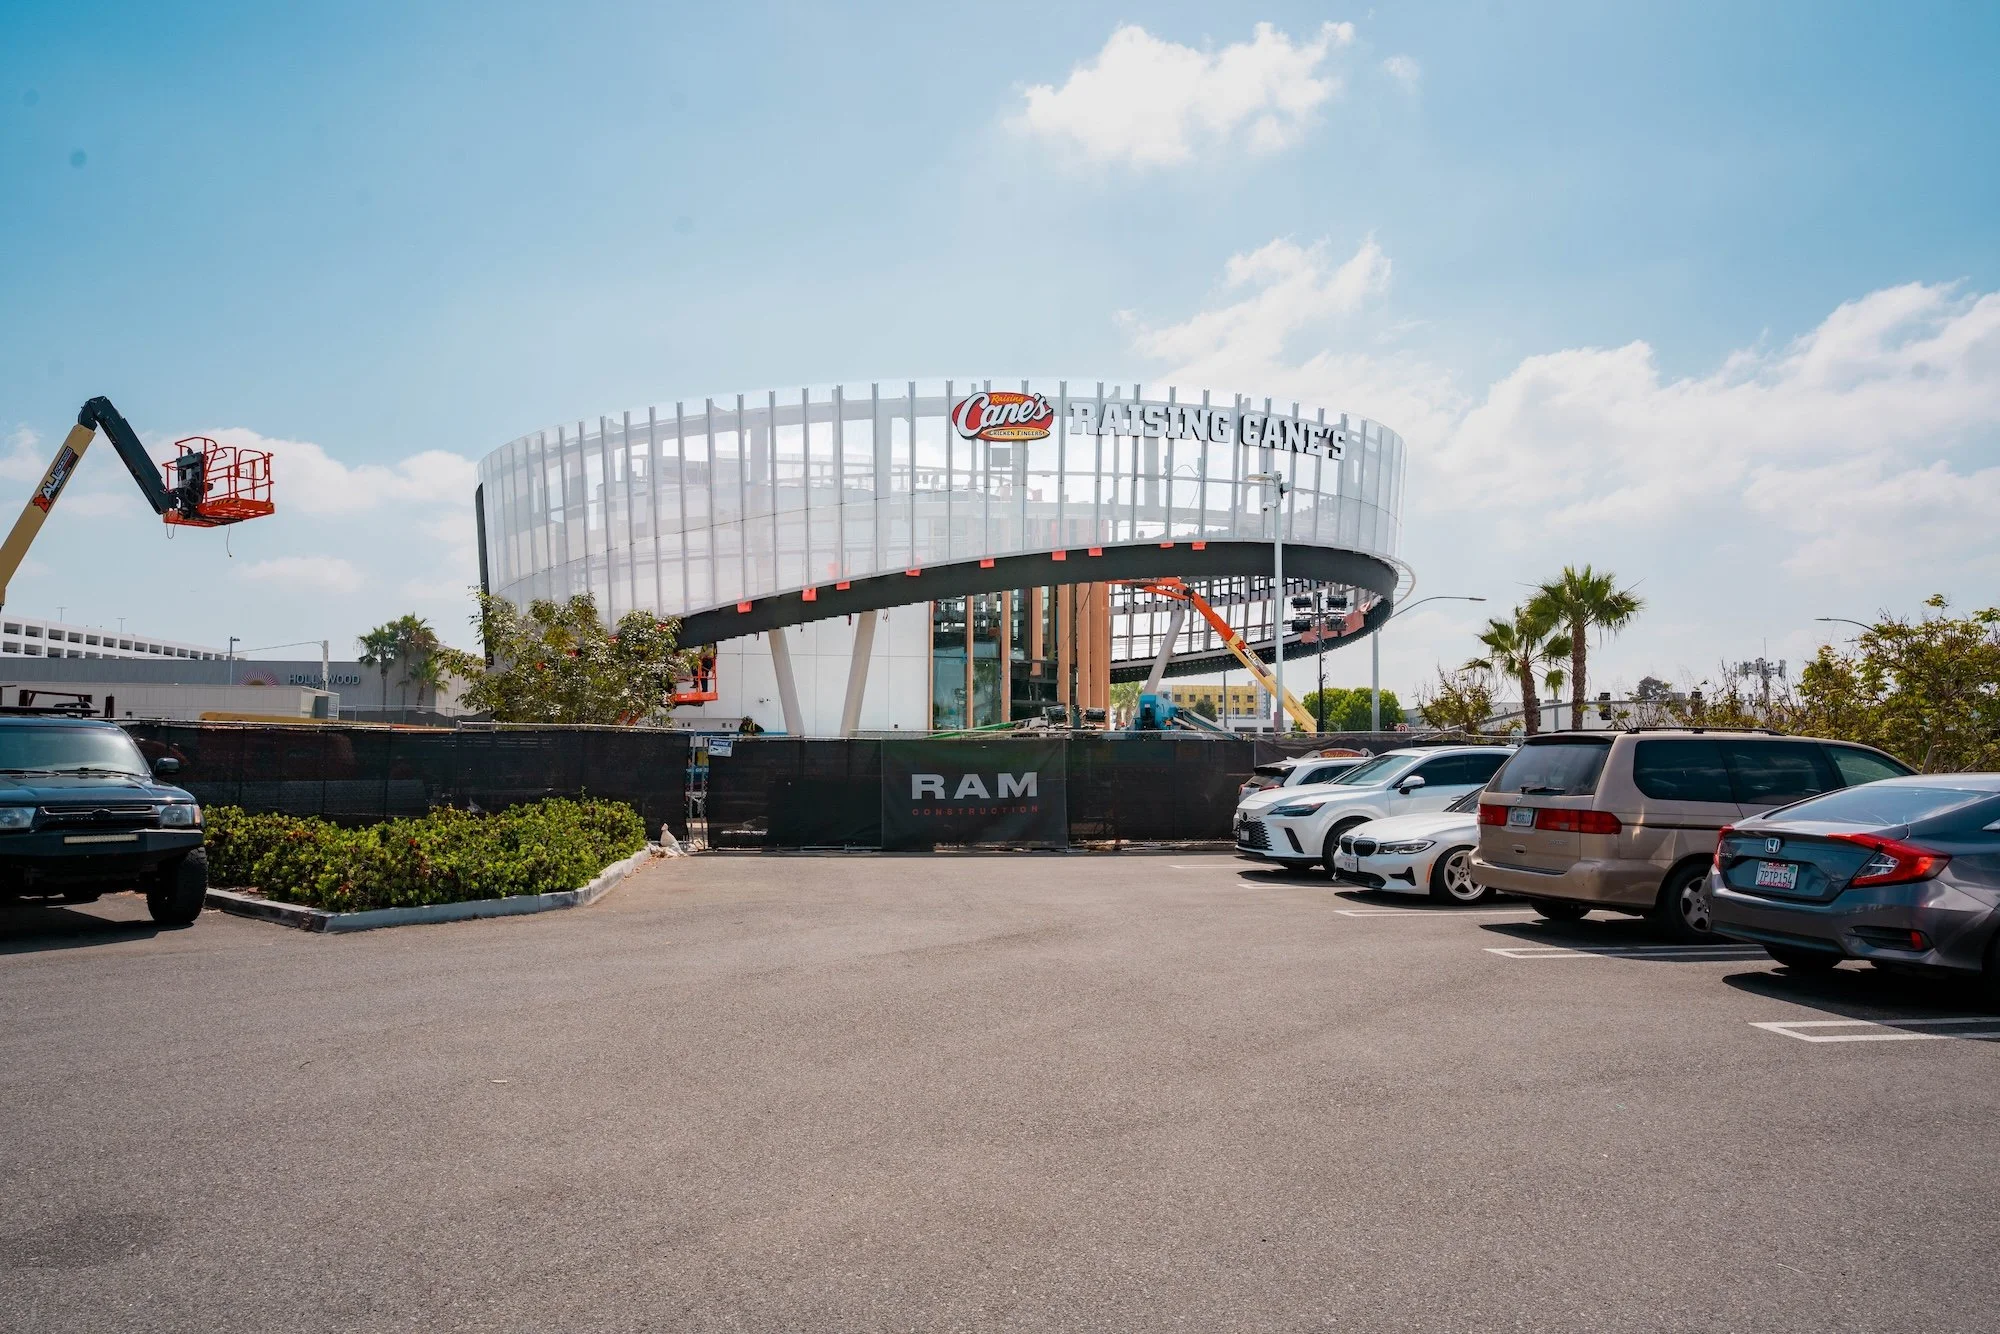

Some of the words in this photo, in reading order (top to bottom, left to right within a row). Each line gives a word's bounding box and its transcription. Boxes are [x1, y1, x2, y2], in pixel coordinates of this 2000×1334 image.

[991, 394, 1025, 404] Raising
[956, 392, 1053, 438] Cane's
[1070, 402, 1231, 443] RAISING
[1241, 414, 1347, 460] CANE'S
[911, 772, 1038, 800] RAM
[912, 804, 1038, 816] CONSTRUCTION
